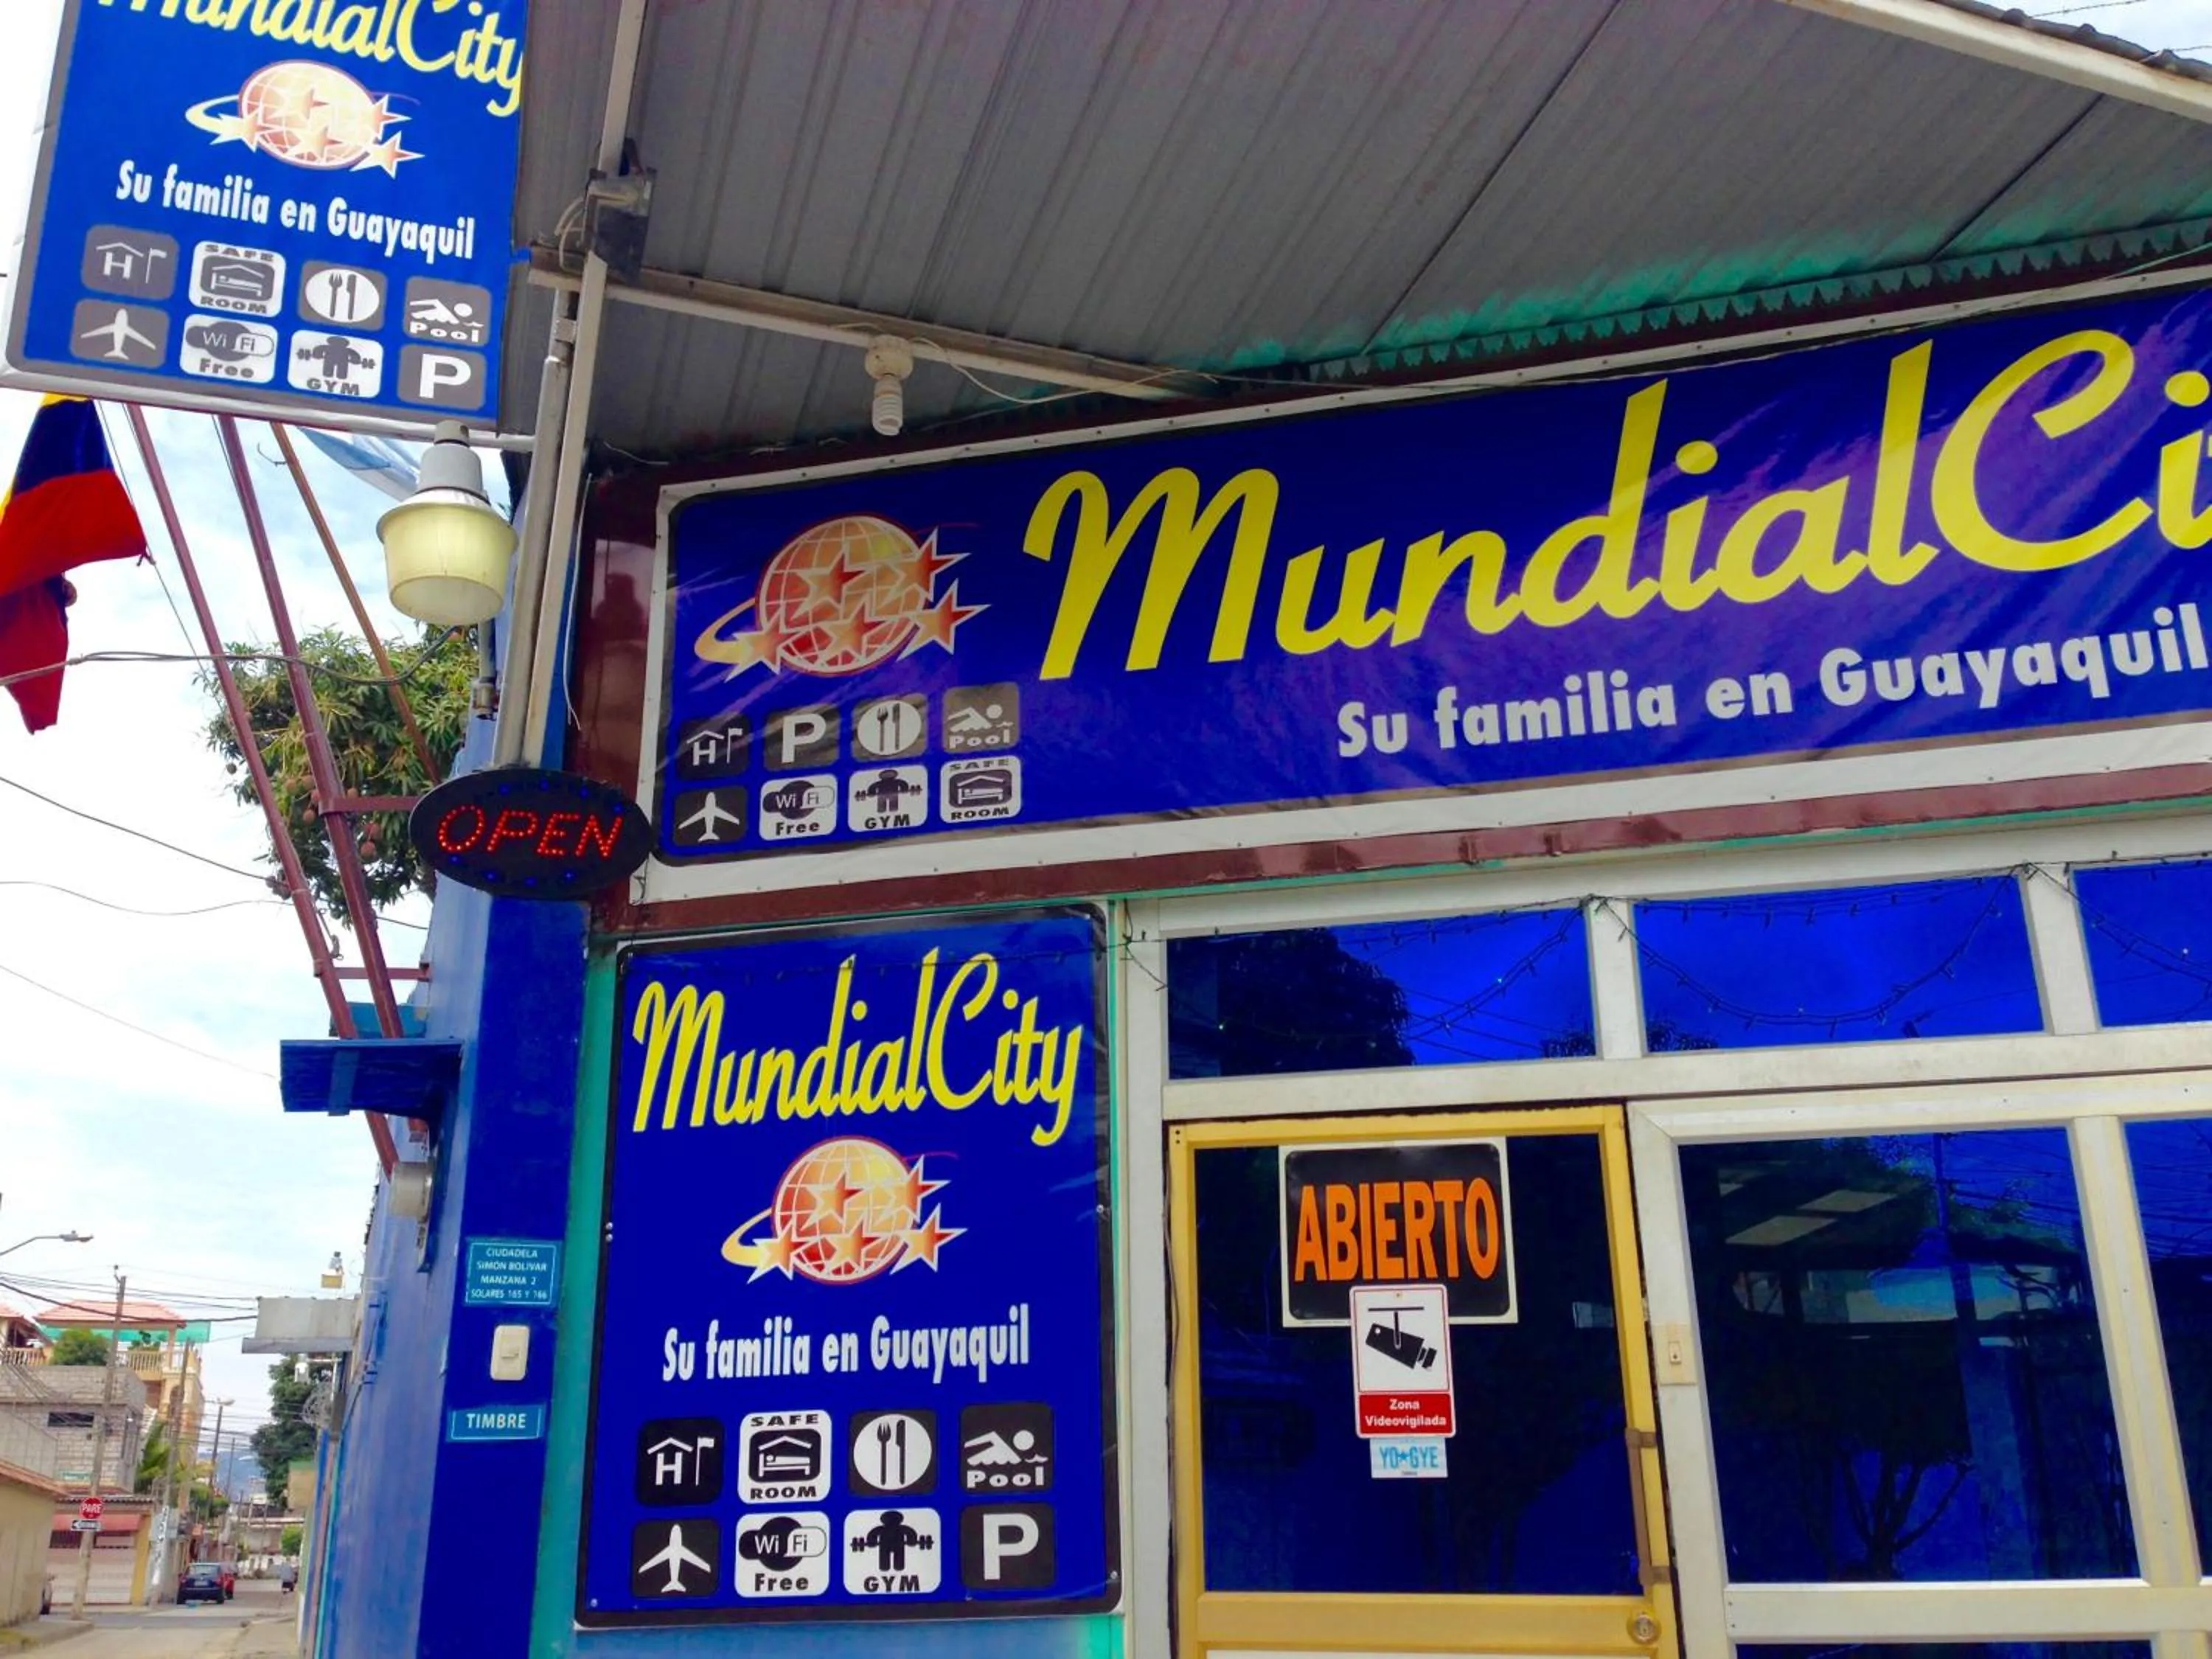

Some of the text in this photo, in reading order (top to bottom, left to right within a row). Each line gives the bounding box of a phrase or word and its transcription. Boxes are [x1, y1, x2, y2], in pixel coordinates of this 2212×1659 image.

[98, 0, 522, 116] undialCity
[116, 160, 476, 264] Su familia en Guayaquil
[204, 244, 274, 262] SAFE
[200, 296, 268, 314] ROOM
[410, 321, 480, 343] Pool
[199, 358, 254, 378] Free
[420, 353, 471, 399] P
[307, 378, 360, 397] GYM
[1338, 602, 2209, 758] Su familia en Guayaquil
[781, 713, 828, 764] P
[949, 728, 1011, 748] Pool
[949, 759, 1009, 771] SAFE
[864, 813, 911, 830] GYM
[950, 807, 1010, 821] ROOM
[438, 804, 624, 858] OPEN
[775, 821, 821, 835] Free
[631, 946, 1084, 1147] MundialCity
[1294, 1178, 1500, 1281] ABIERTO
[486, 1248, 538, 1258] CIUDADELA
[480, 1274, 527, 1285] MANZANA
[471, 1288, 505, 1298] SOLARES
[663, 1303, 1029, 1384] Su familia en Guayaquil
[1389, 1399, 1420, 1411] Zona
[466, 1413, 527, 1429] TIMBRE
[751, 1413, 819, 1427] SAFE
[1365, 1416, 1447, 1429] Videovigilada
[967, 1466, 1045, 1489] Pool
[750, 1486, 816, 1500] ROOM
[82, 1503, 102, 1513] PARE
[983, 1513, 1040, 1580] P
[754, 1573, 810, 1592] Free
[863, 1575, 920, 1593] GYM
